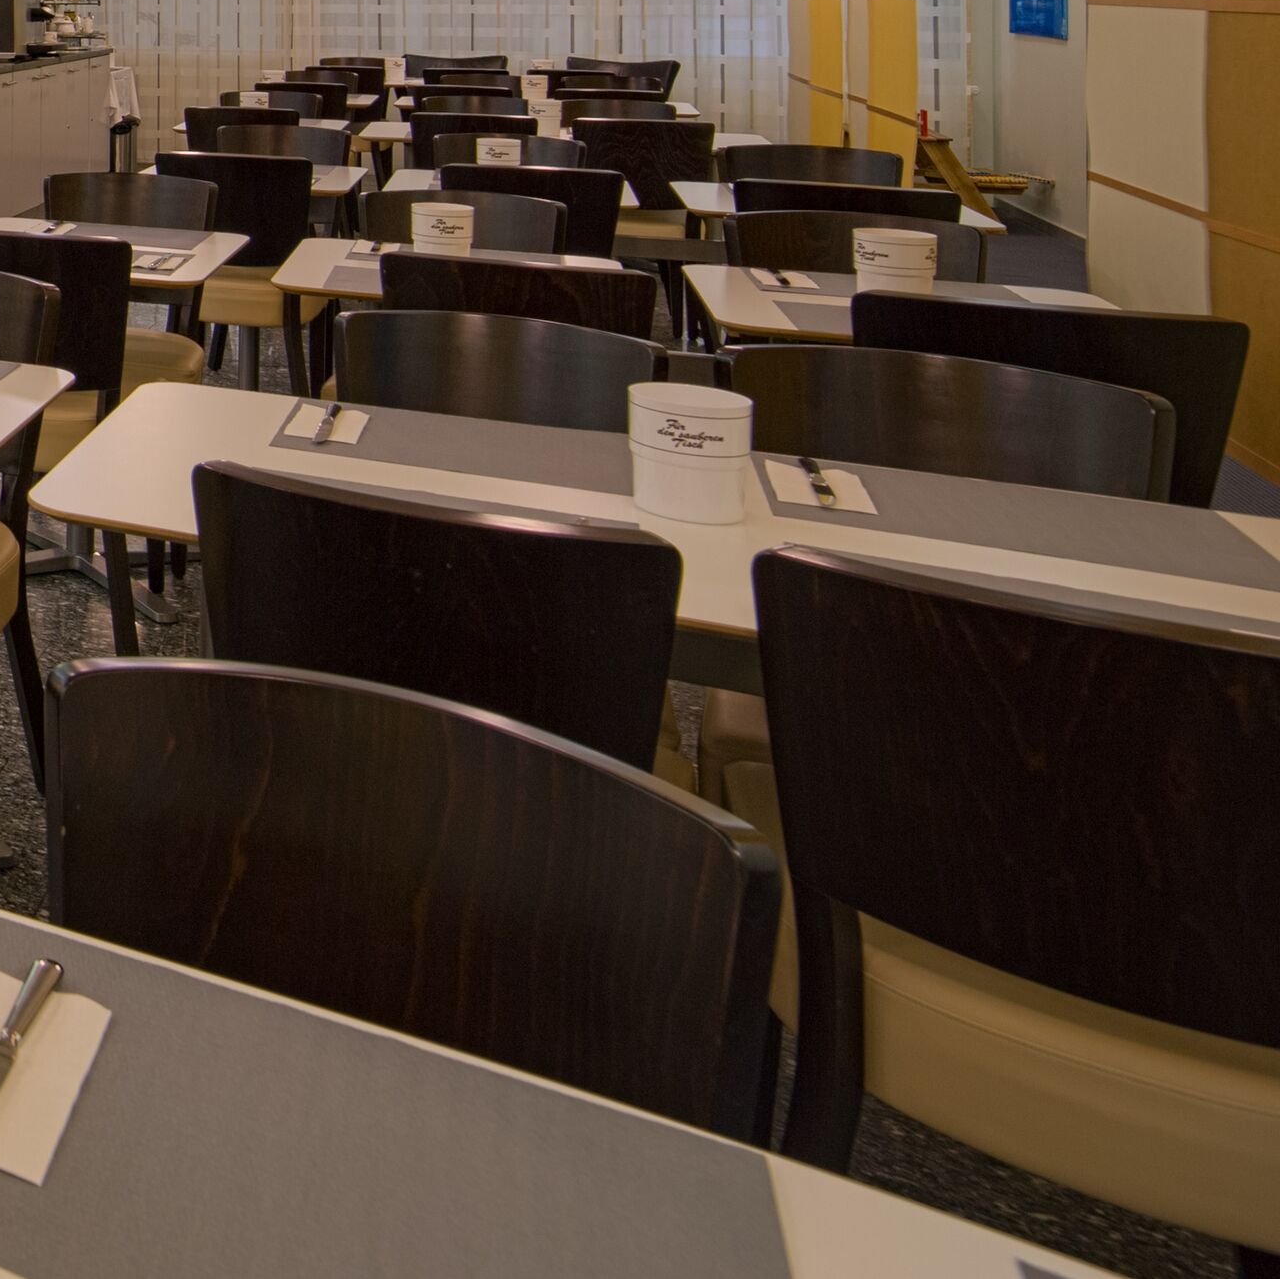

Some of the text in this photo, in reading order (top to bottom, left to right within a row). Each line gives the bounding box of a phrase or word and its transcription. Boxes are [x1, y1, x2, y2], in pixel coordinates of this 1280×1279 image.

[665, 418, 686, 431] Für
[657, 426, 724, 442] den sauberen
[671, 437, 704, 450] Tisch
